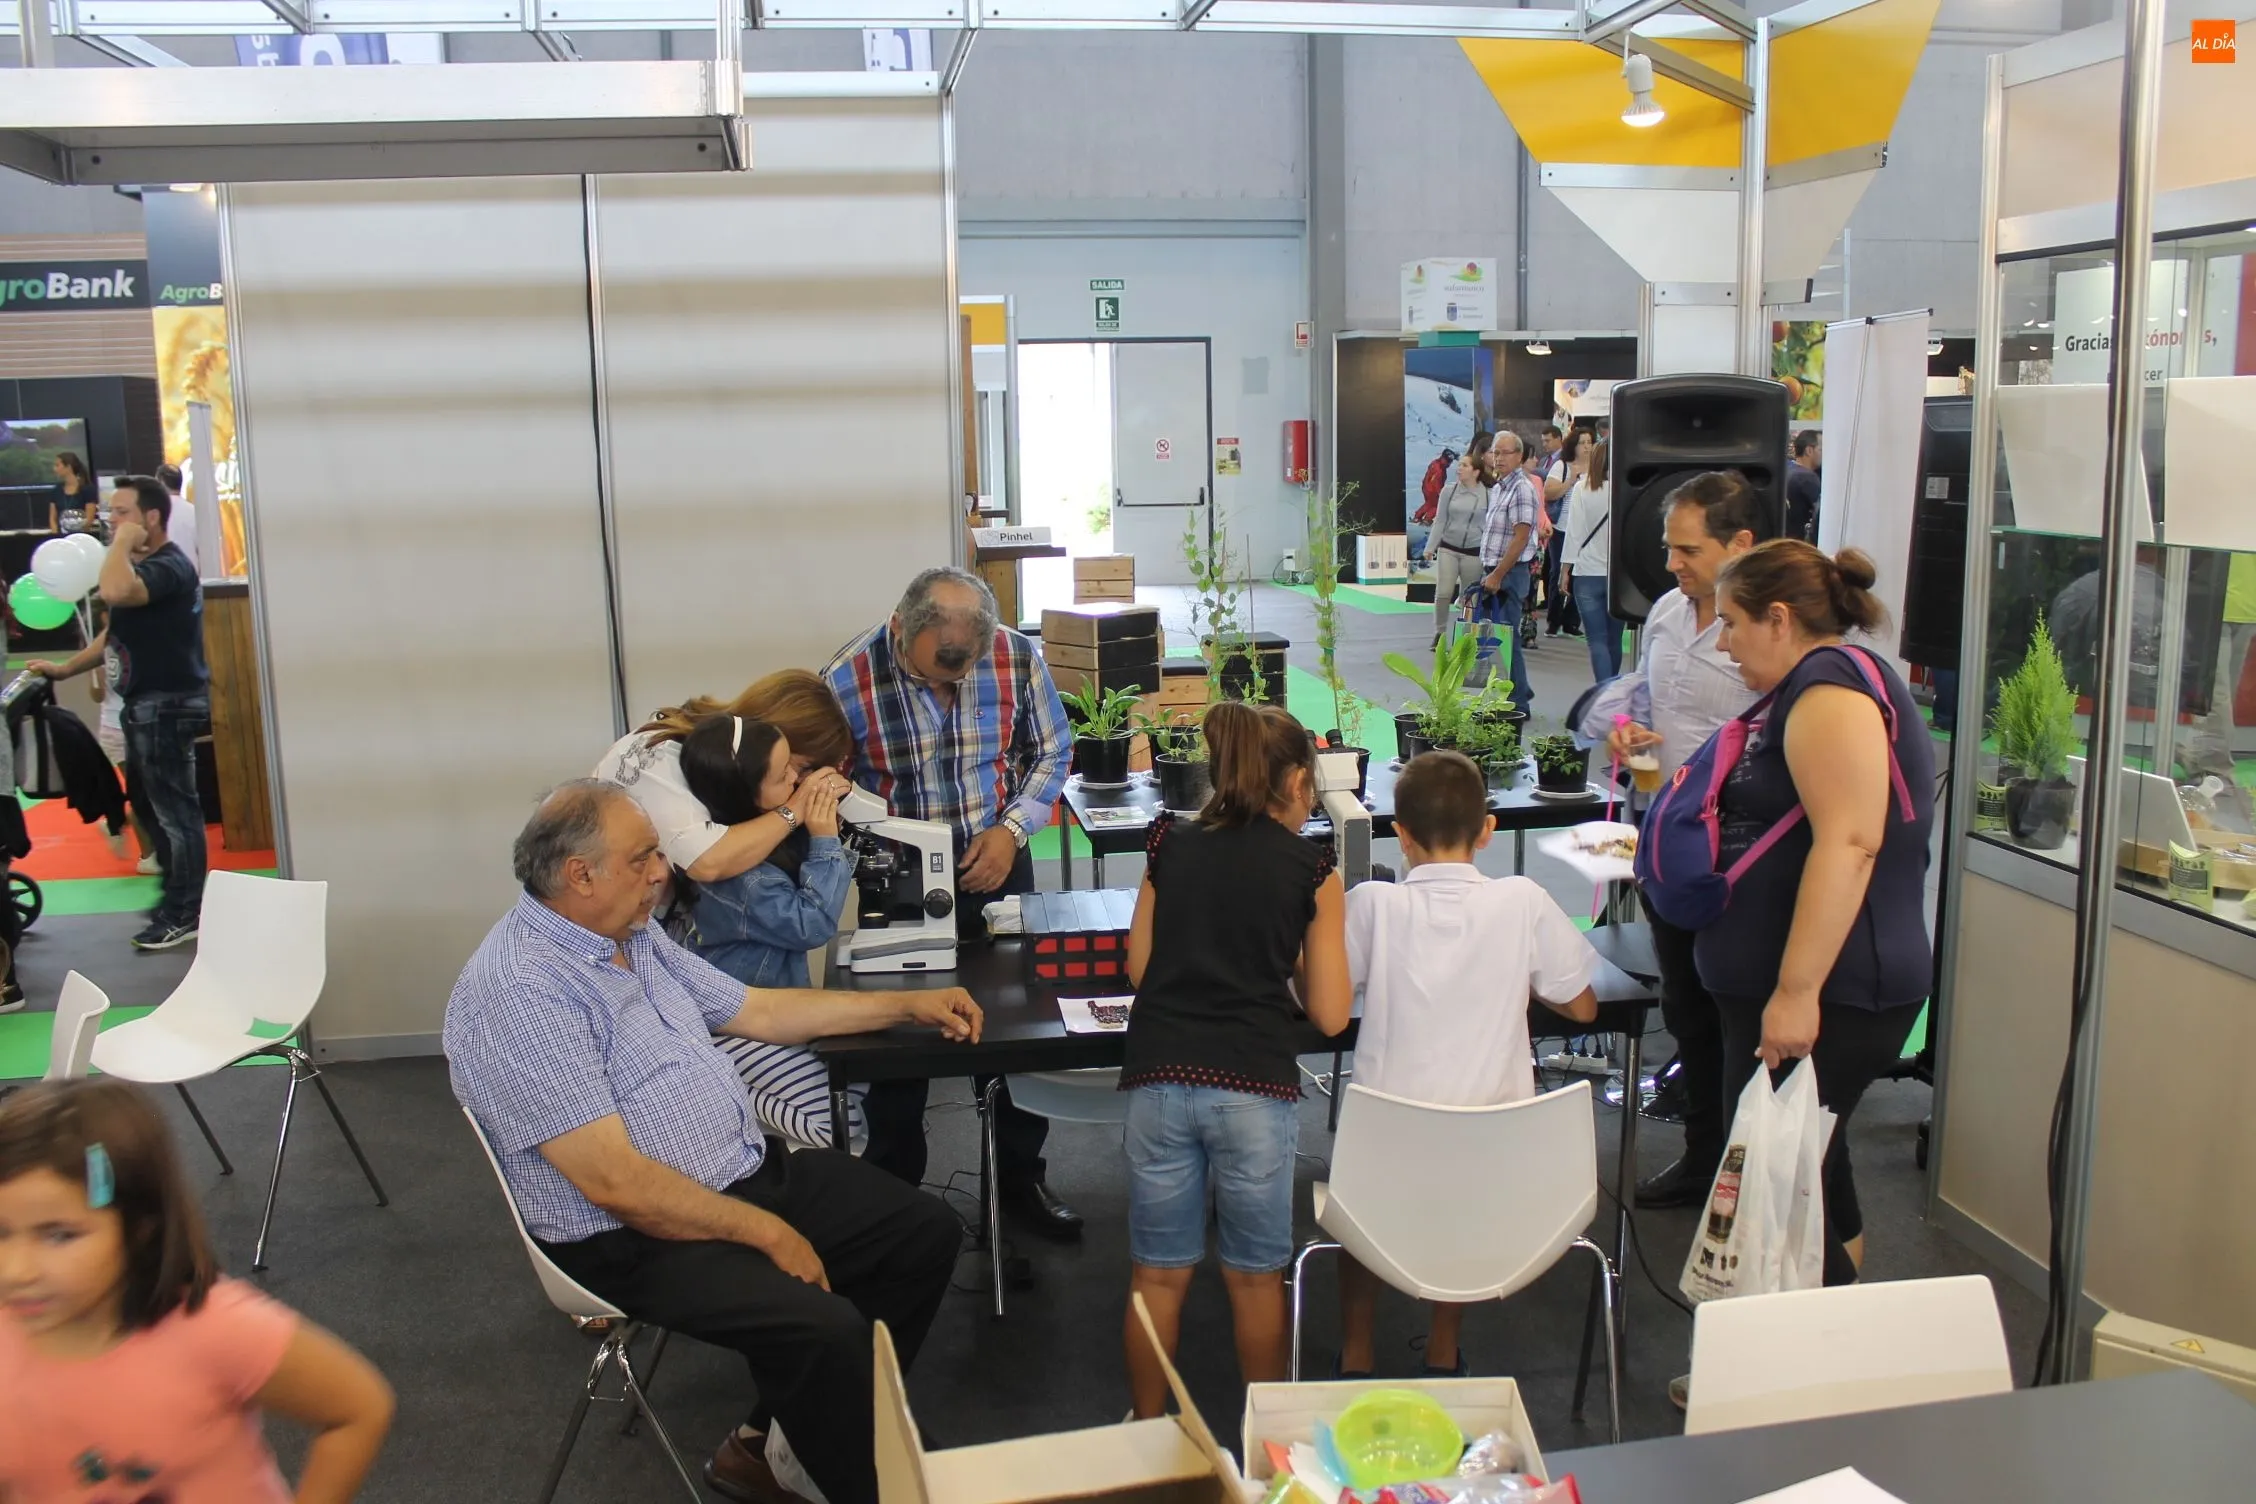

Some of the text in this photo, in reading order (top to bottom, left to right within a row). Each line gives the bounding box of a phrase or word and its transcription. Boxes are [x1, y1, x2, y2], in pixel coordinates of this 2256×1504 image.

[1091, 280, 1122, 290] SALIDA
[160, 283, 223, 303] AgroB
[1000, 531, 1033, 542] Pinhel
